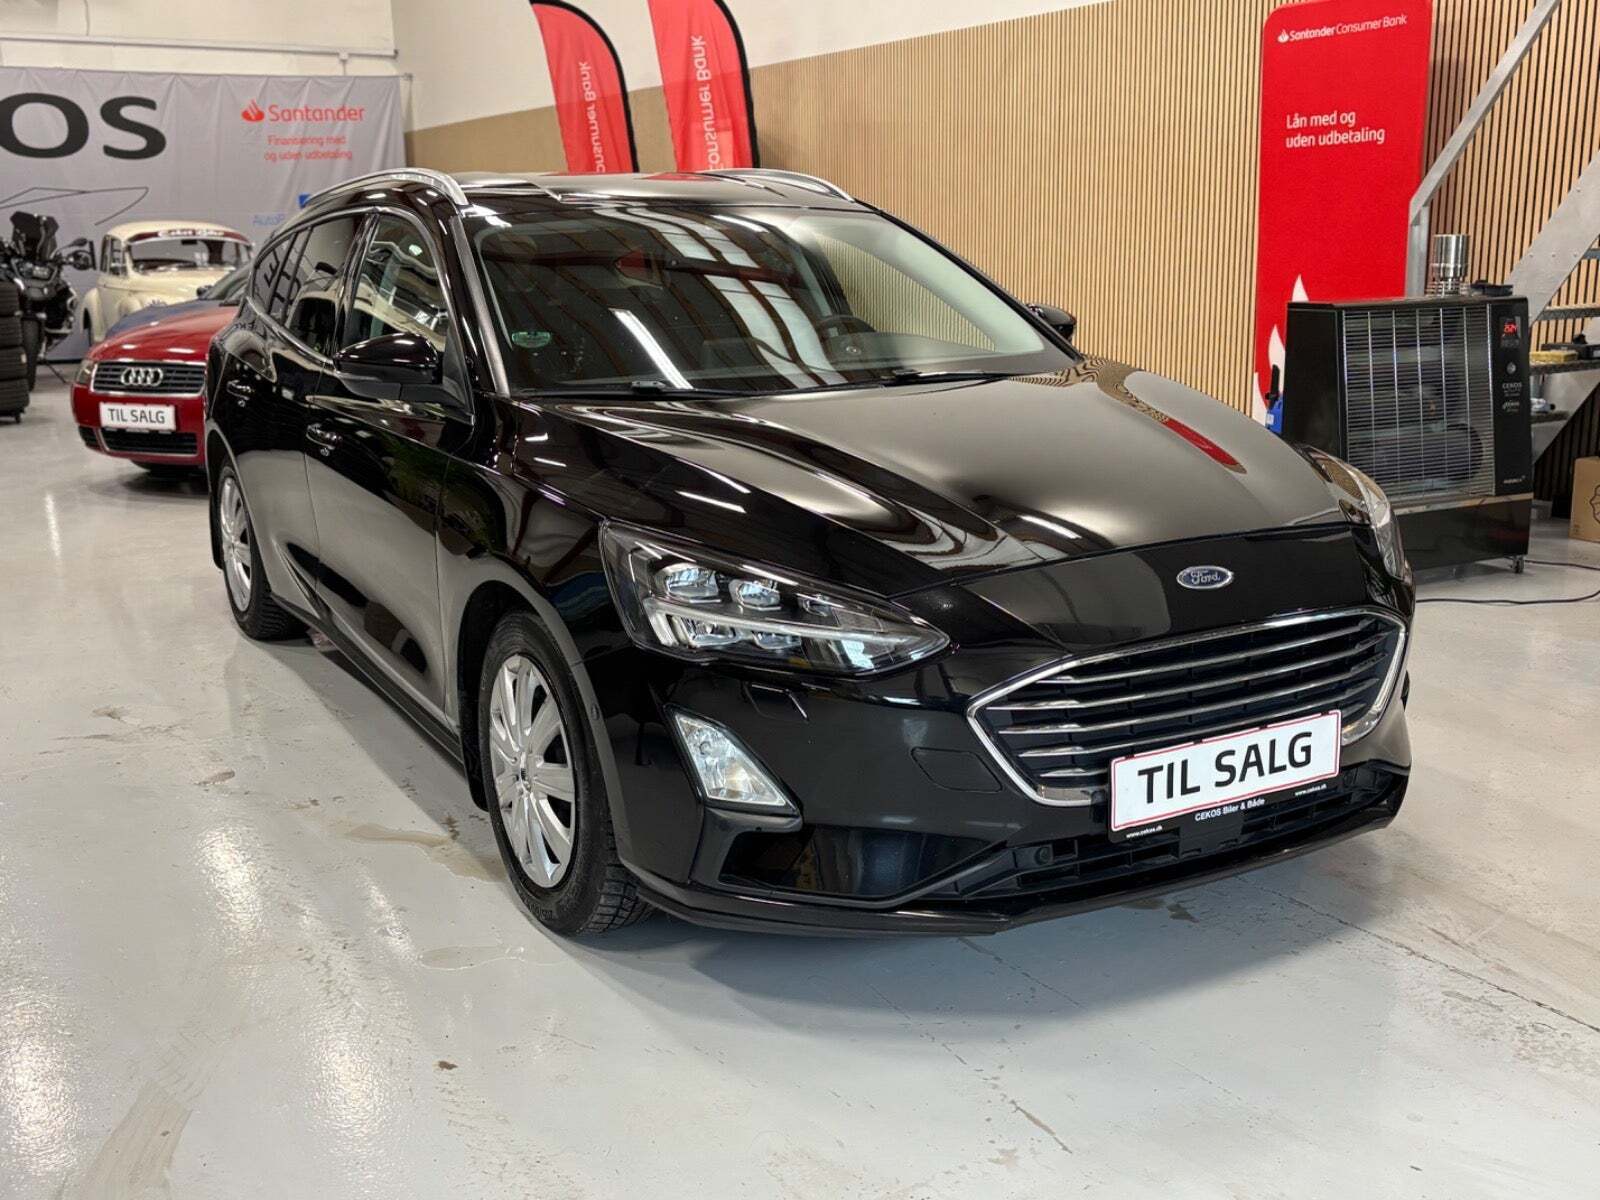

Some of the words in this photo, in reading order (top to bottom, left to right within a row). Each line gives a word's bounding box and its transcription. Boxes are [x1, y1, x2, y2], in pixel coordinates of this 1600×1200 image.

[1289, 26, 1335, 41] Santander
[1335, 19, 1381, 35] Consumer
[1382, 13, 1407, 28] Bank
[268, 104, 365, 122] Santander
[1286, 112, 1308, 129] Lån
[1309, 110, 1337, 127] med
[1339, 111, 1356, 128] og
[1285, 132, 1316, 148] uden
[1318, 127, 1385, 146] udbetaling
[108, 408, 128, 422] TIL
[130, 409, 165, 424] SALG
[1186, 569, 1221, 585] Ford
[1137, 758, 1201, 804] TIL
[1214, 731, 1313, 788] SALG
[1194, 808, 1222, 822] CEKOS
